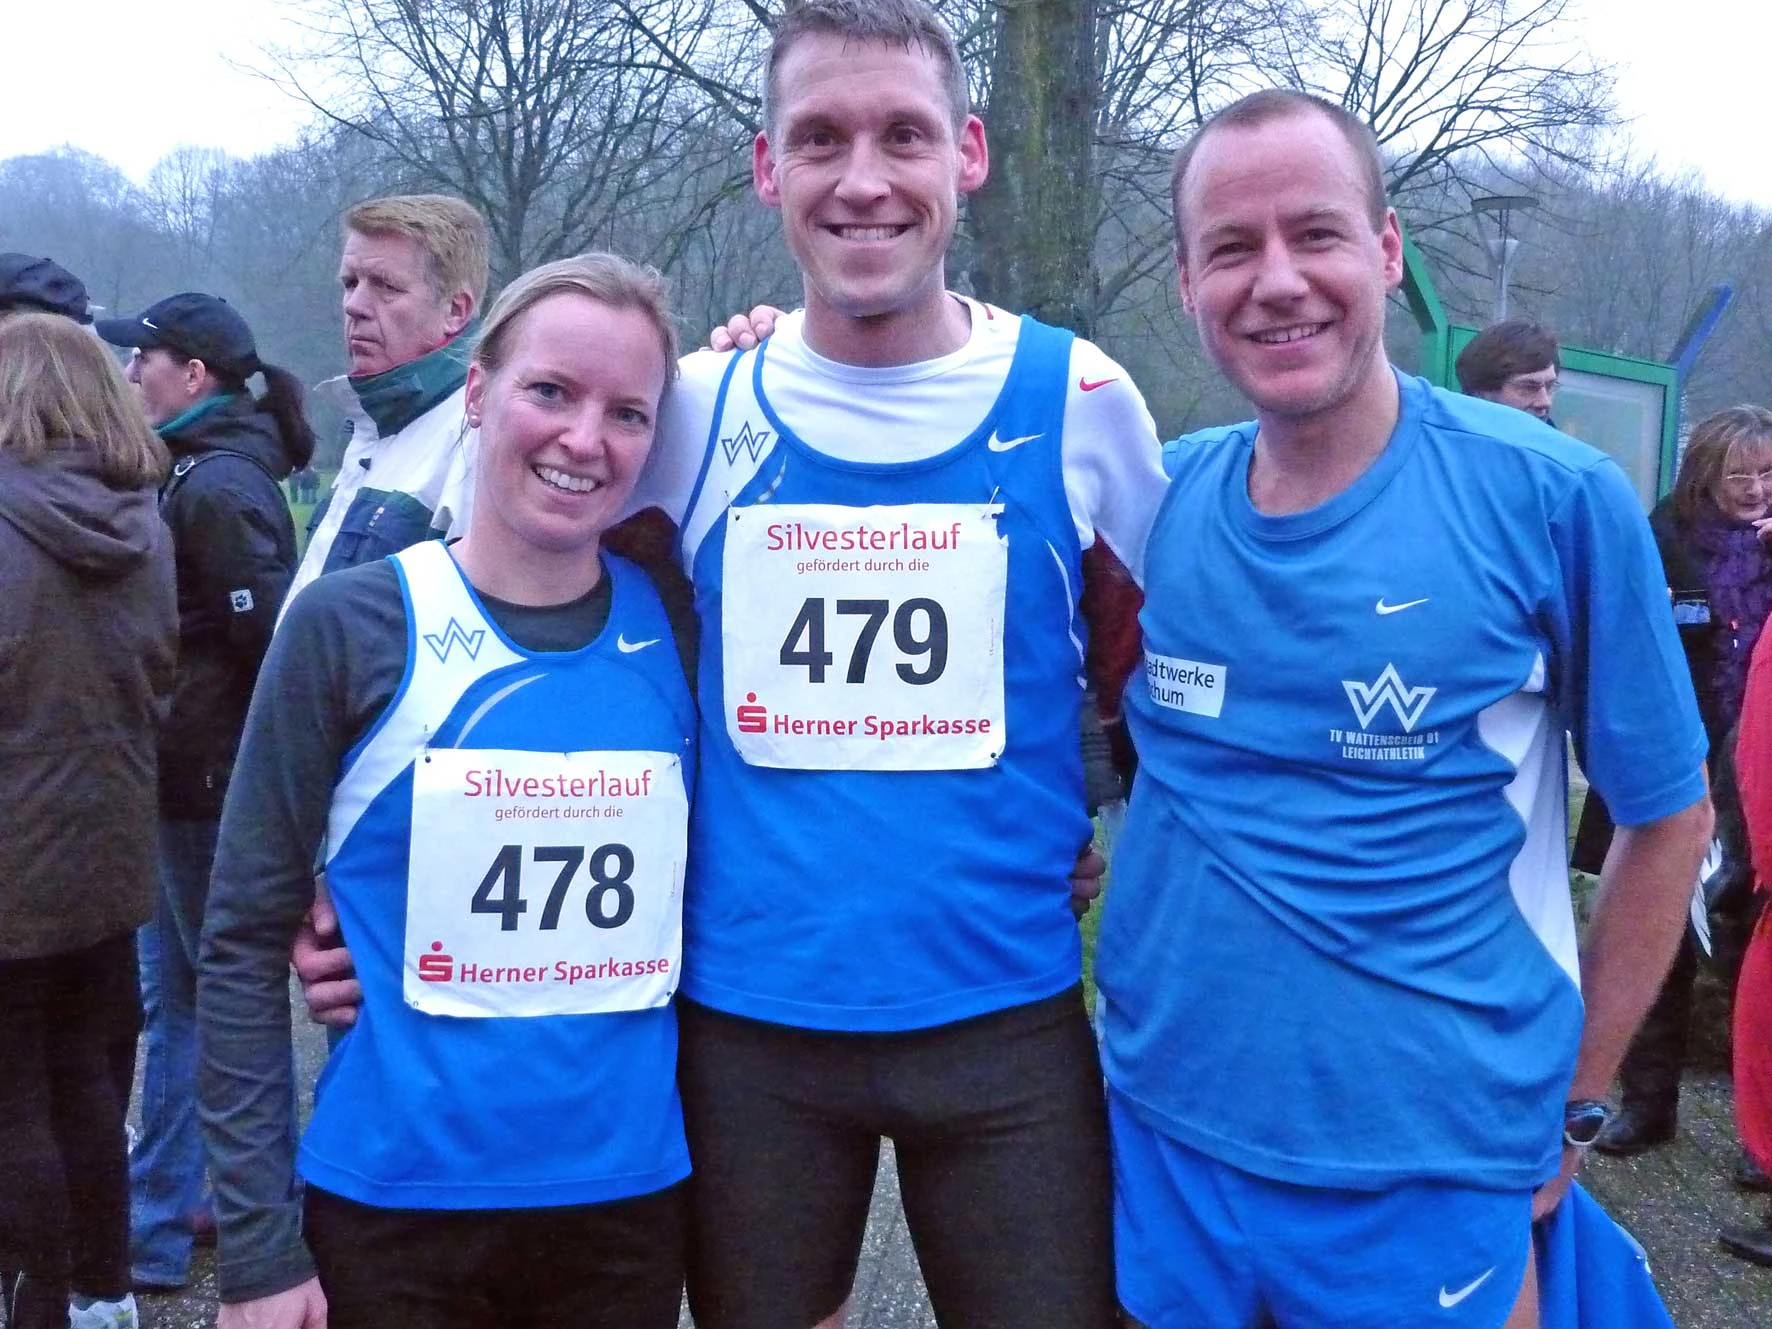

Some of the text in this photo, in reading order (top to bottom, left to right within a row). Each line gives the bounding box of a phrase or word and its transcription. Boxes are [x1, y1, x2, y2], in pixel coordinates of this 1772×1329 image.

[767, 523, 962, 551] Silvesterlauf
[796, 558, 930, 574] gefördert durch die
[779, 597, 949, 685] 479
[774, 714, 857, 735] Herner
[864, 714, 991, 740] Sparkasse
[1330, 729, 1343, 742] TV
[1342, 746, 1425, 760] LEICHTATHLETIK
[464, 769, 652, 798] Silvesterlauf
[495, 805, 624, 821] gefördert durch die
[471, 843, 635, 931] 478
[460, 963, 549, 984] Herner
[553, 957, 670, 985] Sparkasse
